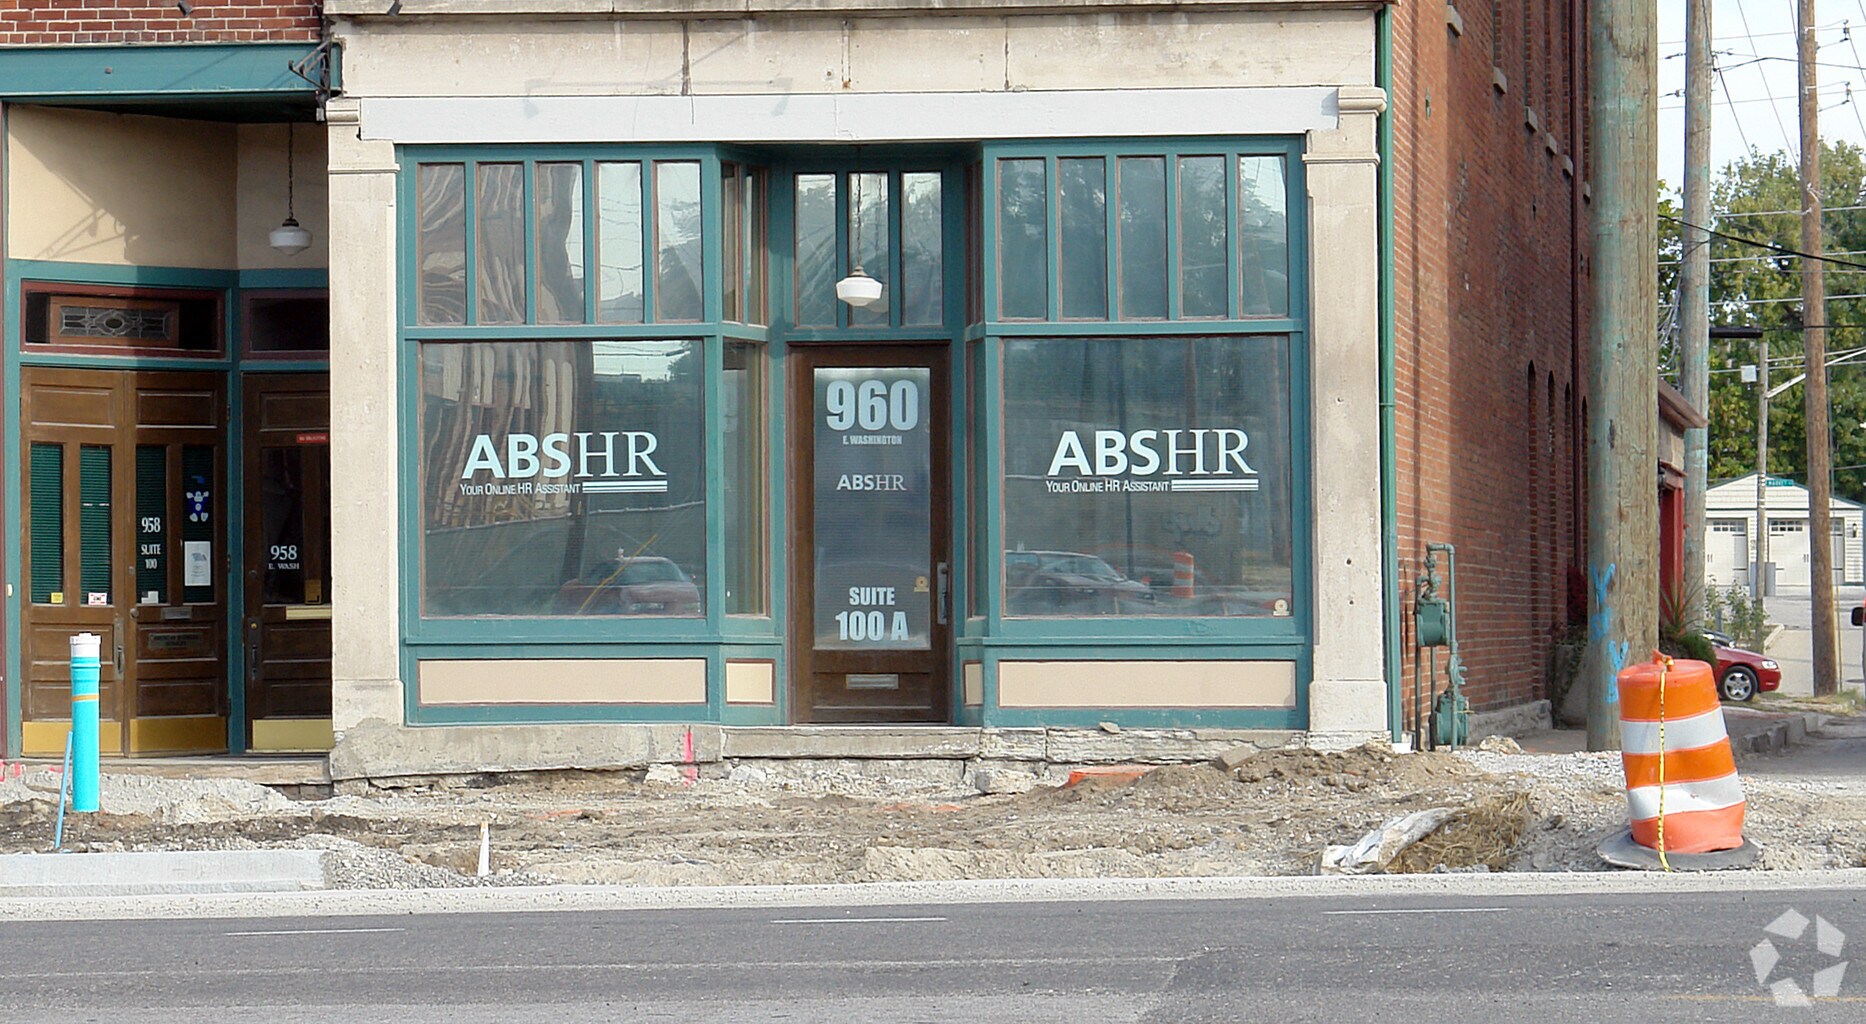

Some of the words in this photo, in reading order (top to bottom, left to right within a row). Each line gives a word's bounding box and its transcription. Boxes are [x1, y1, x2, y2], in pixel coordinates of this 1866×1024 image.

[826, 379, 919, 431] 960
[850, 435, 903, 445] WASHINGTON
[461, 430, 668, 479] ABSHR
[1047, 429, 1259, 476] ABSHR
[459, 483, 485, 495] YOUR
[484, 483, 516, 495] ONLINE
[517, 482, 533, 495] HR
[535, 482, 581, 495] ASSISTANT
[836, 474, 908, 491] ABSHR
[1046, 480, 1072, 493] YOUR
[1071, 480, 1103, 492] ONLINE
[1105, 480, 1120, 492] HR
[1123, 479, 1170, 492] ASSISTANT
[141, 516, 161, 533] 958
[140, 543, 161, 555] SUITE
[270, 544, 298, 560] 958
[145, 558, 158, 569] 100
[277, 562, 300, 570] WASH
[849, 586, 896, 606] SUITE
[835, 610, 885, 641] 100
[890, 611, 909, 641] A
